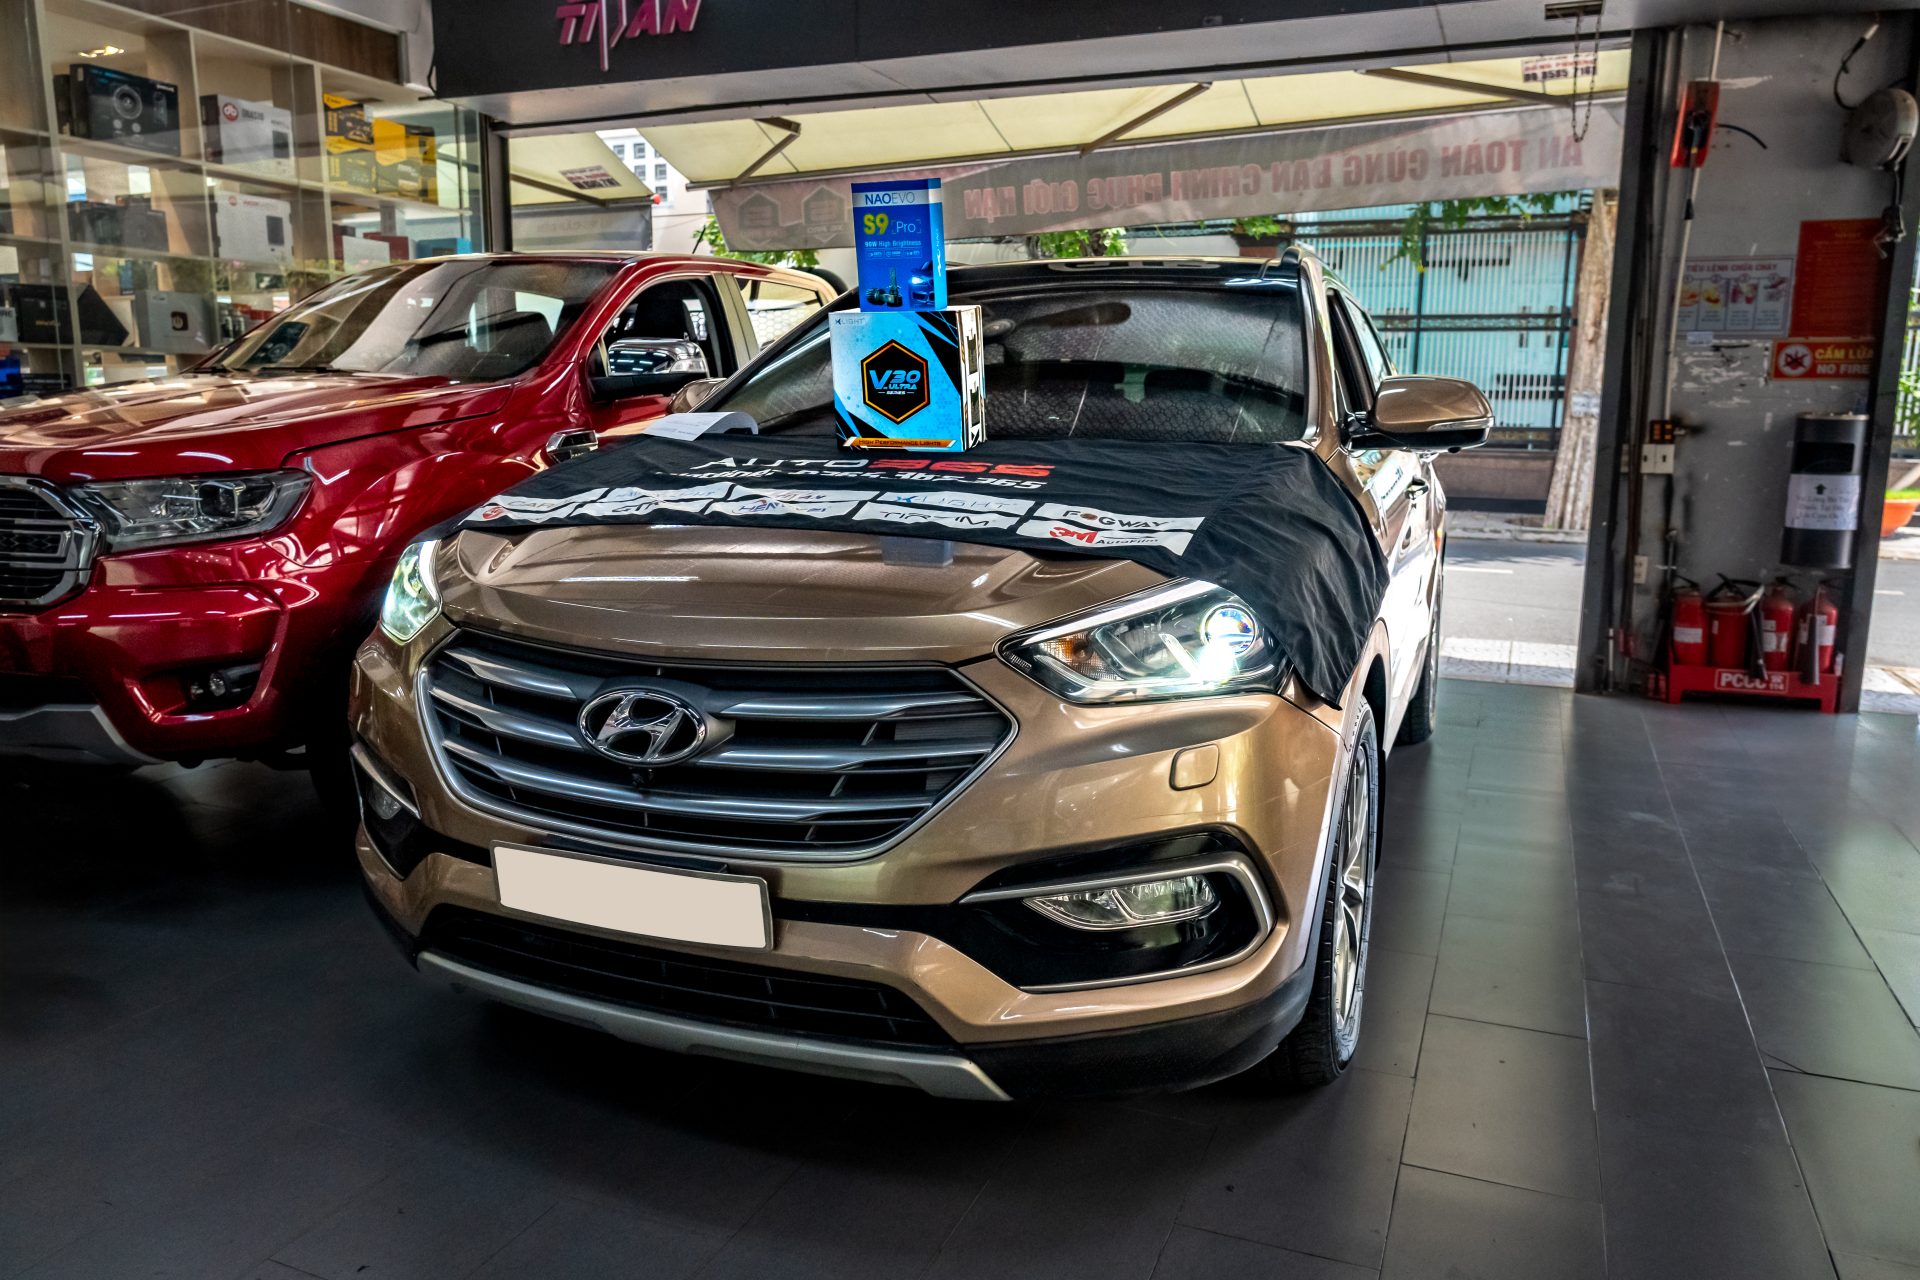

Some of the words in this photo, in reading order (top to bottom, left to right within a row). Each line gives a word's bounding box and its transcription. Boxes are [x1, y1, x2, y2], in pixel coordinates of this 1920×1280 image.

[864, 191, 916, 205] NAOEVO
[863, 213, 889, 235] S9
[1814, 345, 1846, 360] CẤM
[1816, 364, 1838, 375] NO
[1840, 364, 1871, 375] FIRE
[869, 370, 921, 390] V30
[1049, 527, 1098, 544] 3M
